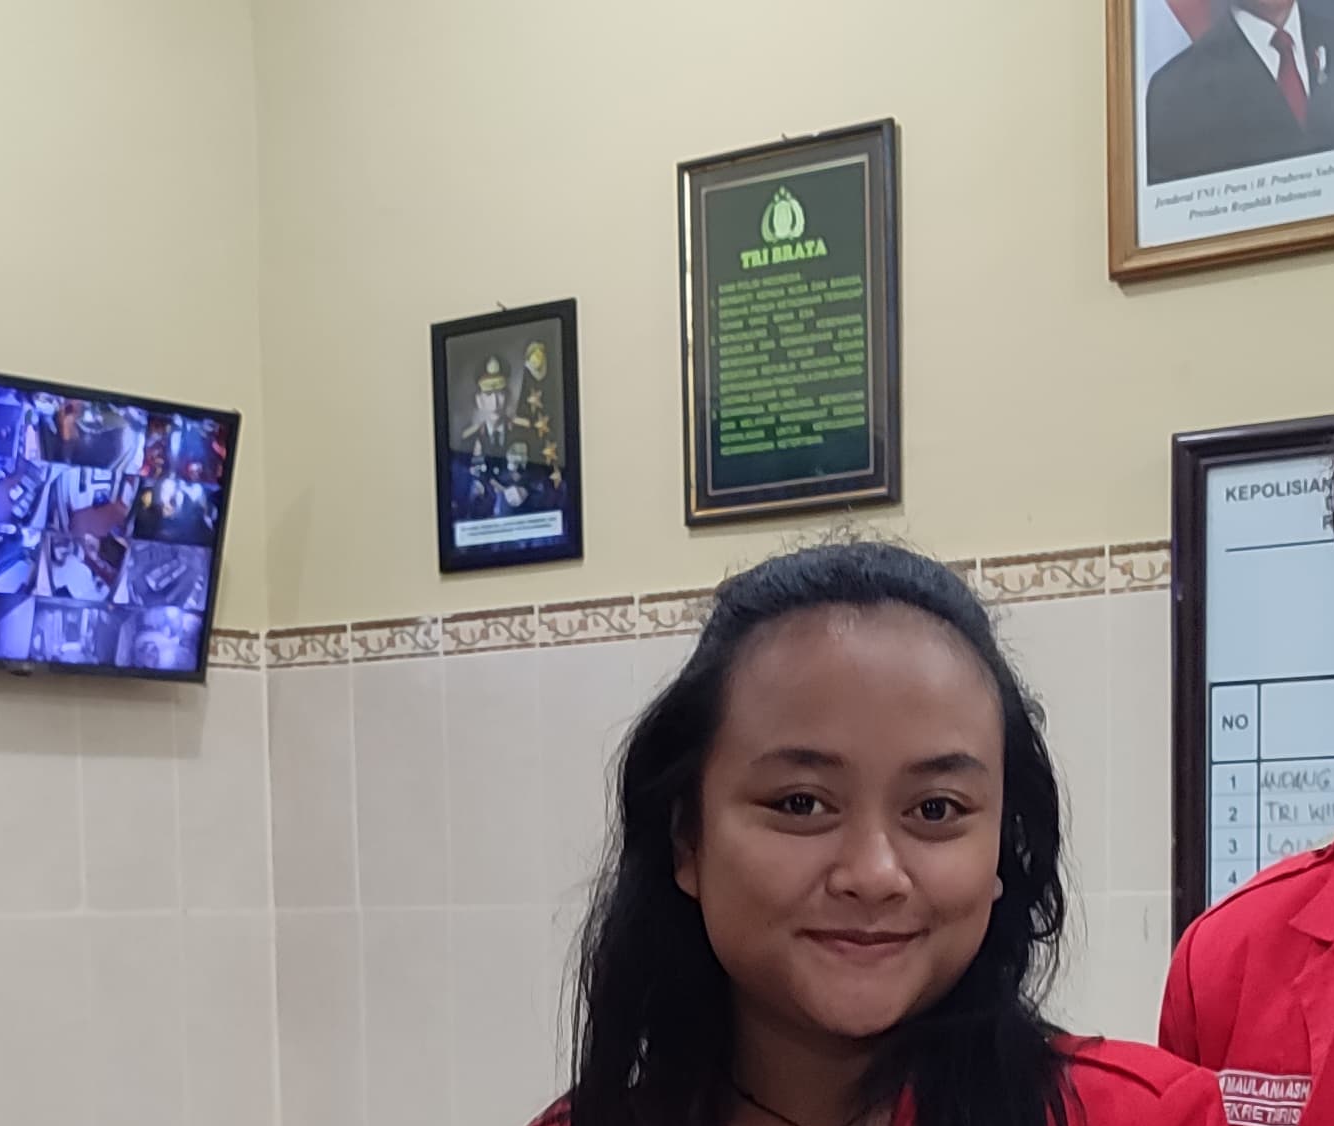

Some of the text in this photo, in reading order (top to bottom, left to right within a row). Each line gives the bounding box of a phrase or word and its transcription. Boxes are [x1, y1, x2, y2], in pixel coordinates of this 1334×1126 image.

[1221, 713, 1250, 731] NO
[1229, 807, 1238, 822] 2
[1266, 800, 1298, 823] TRI
[1228, 838, 1238, 855] 3
[1228, 870, 1238, 885] 4
